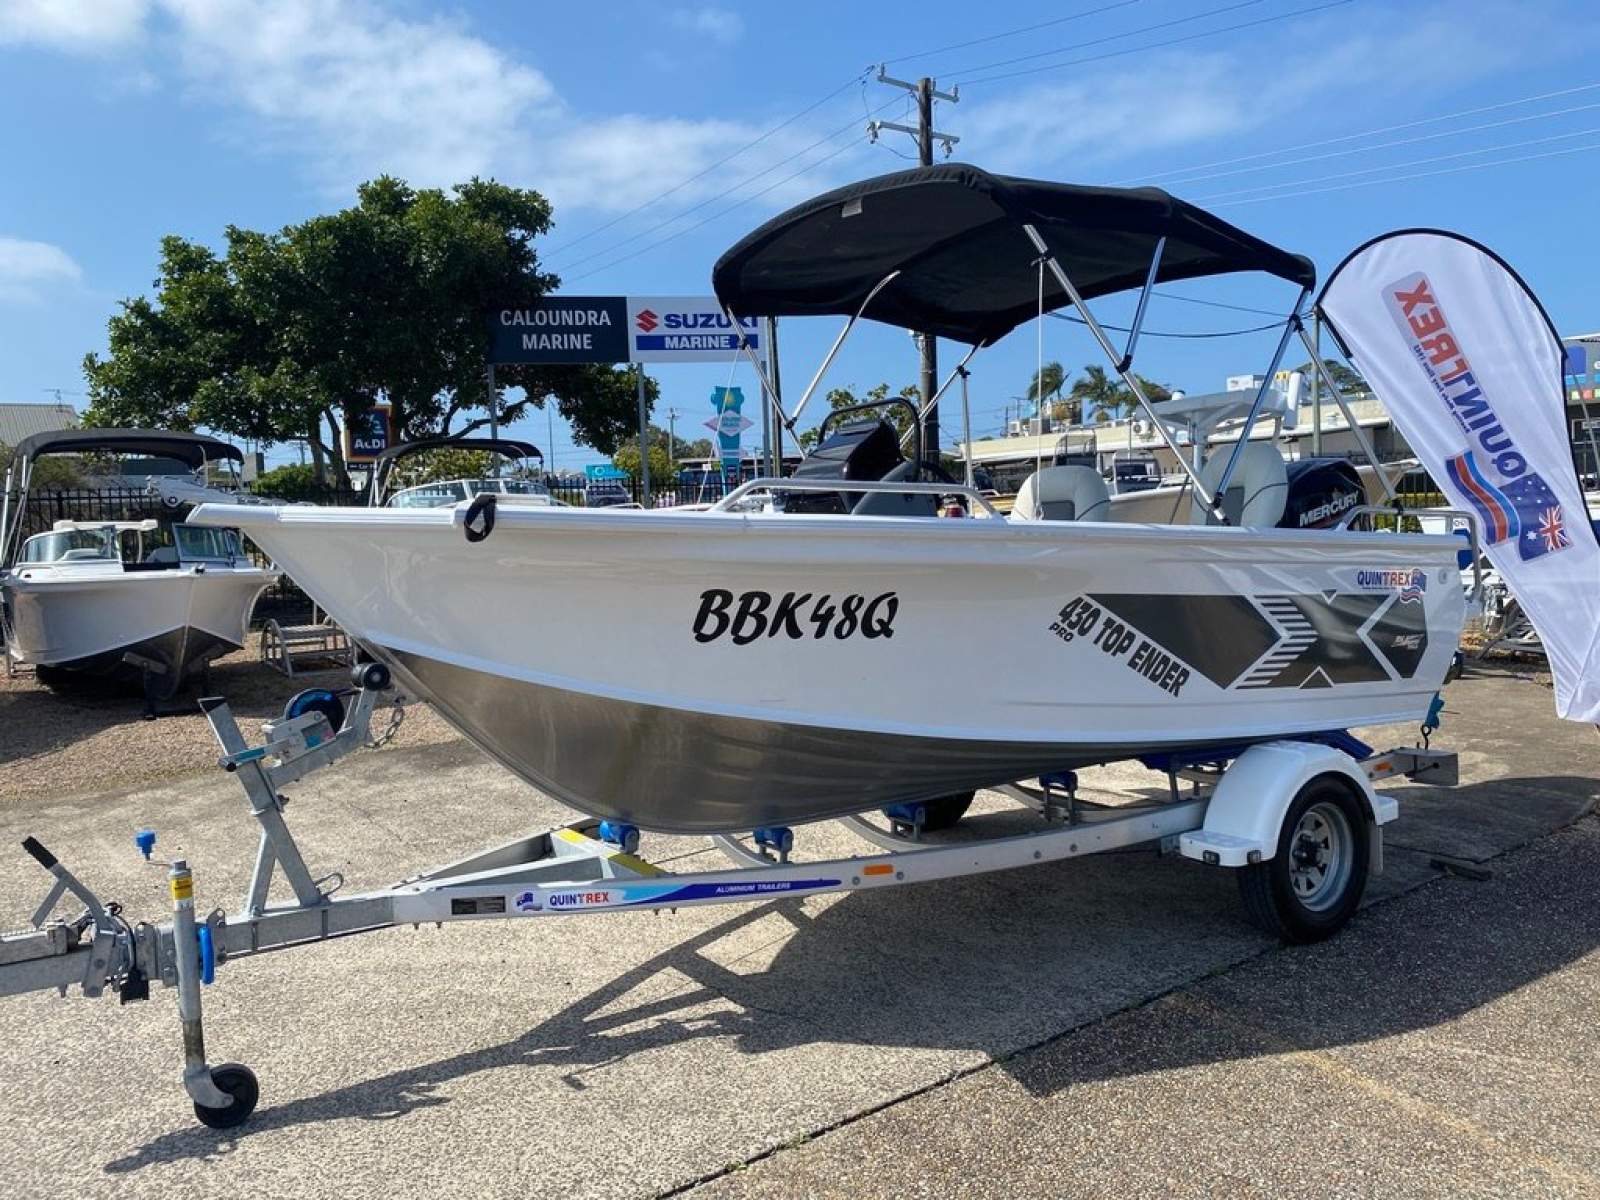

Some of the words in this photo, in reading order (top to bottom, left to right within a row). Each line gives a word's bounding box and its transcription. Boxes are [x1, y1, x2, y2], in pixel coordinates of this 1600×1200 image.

[500, 310, 612, 326] CALOUNDRA
[522, 333, 592, 350] MARINE
[664, 335, 730, 349] MARINE
[354, 438, 386, 449] ALDI
[1300, 490, 1359, 528] MERCURY
[1357, 571, 1411, 586] QUINTREX
[692, 588, 899, 645] BBK48Q
[1048, 622, 1075, 642] PRO
[1058, 596, 1102, 637] 430
[1093, 616, 1136, 657] TOP
[1126, 640, 1190, 698] ENDER
[715, 884, 756, 894] ALUMINIUM
[757, 882, 792, 891] TRAILERS
[549, 891, 609, 907] QUINTREX
